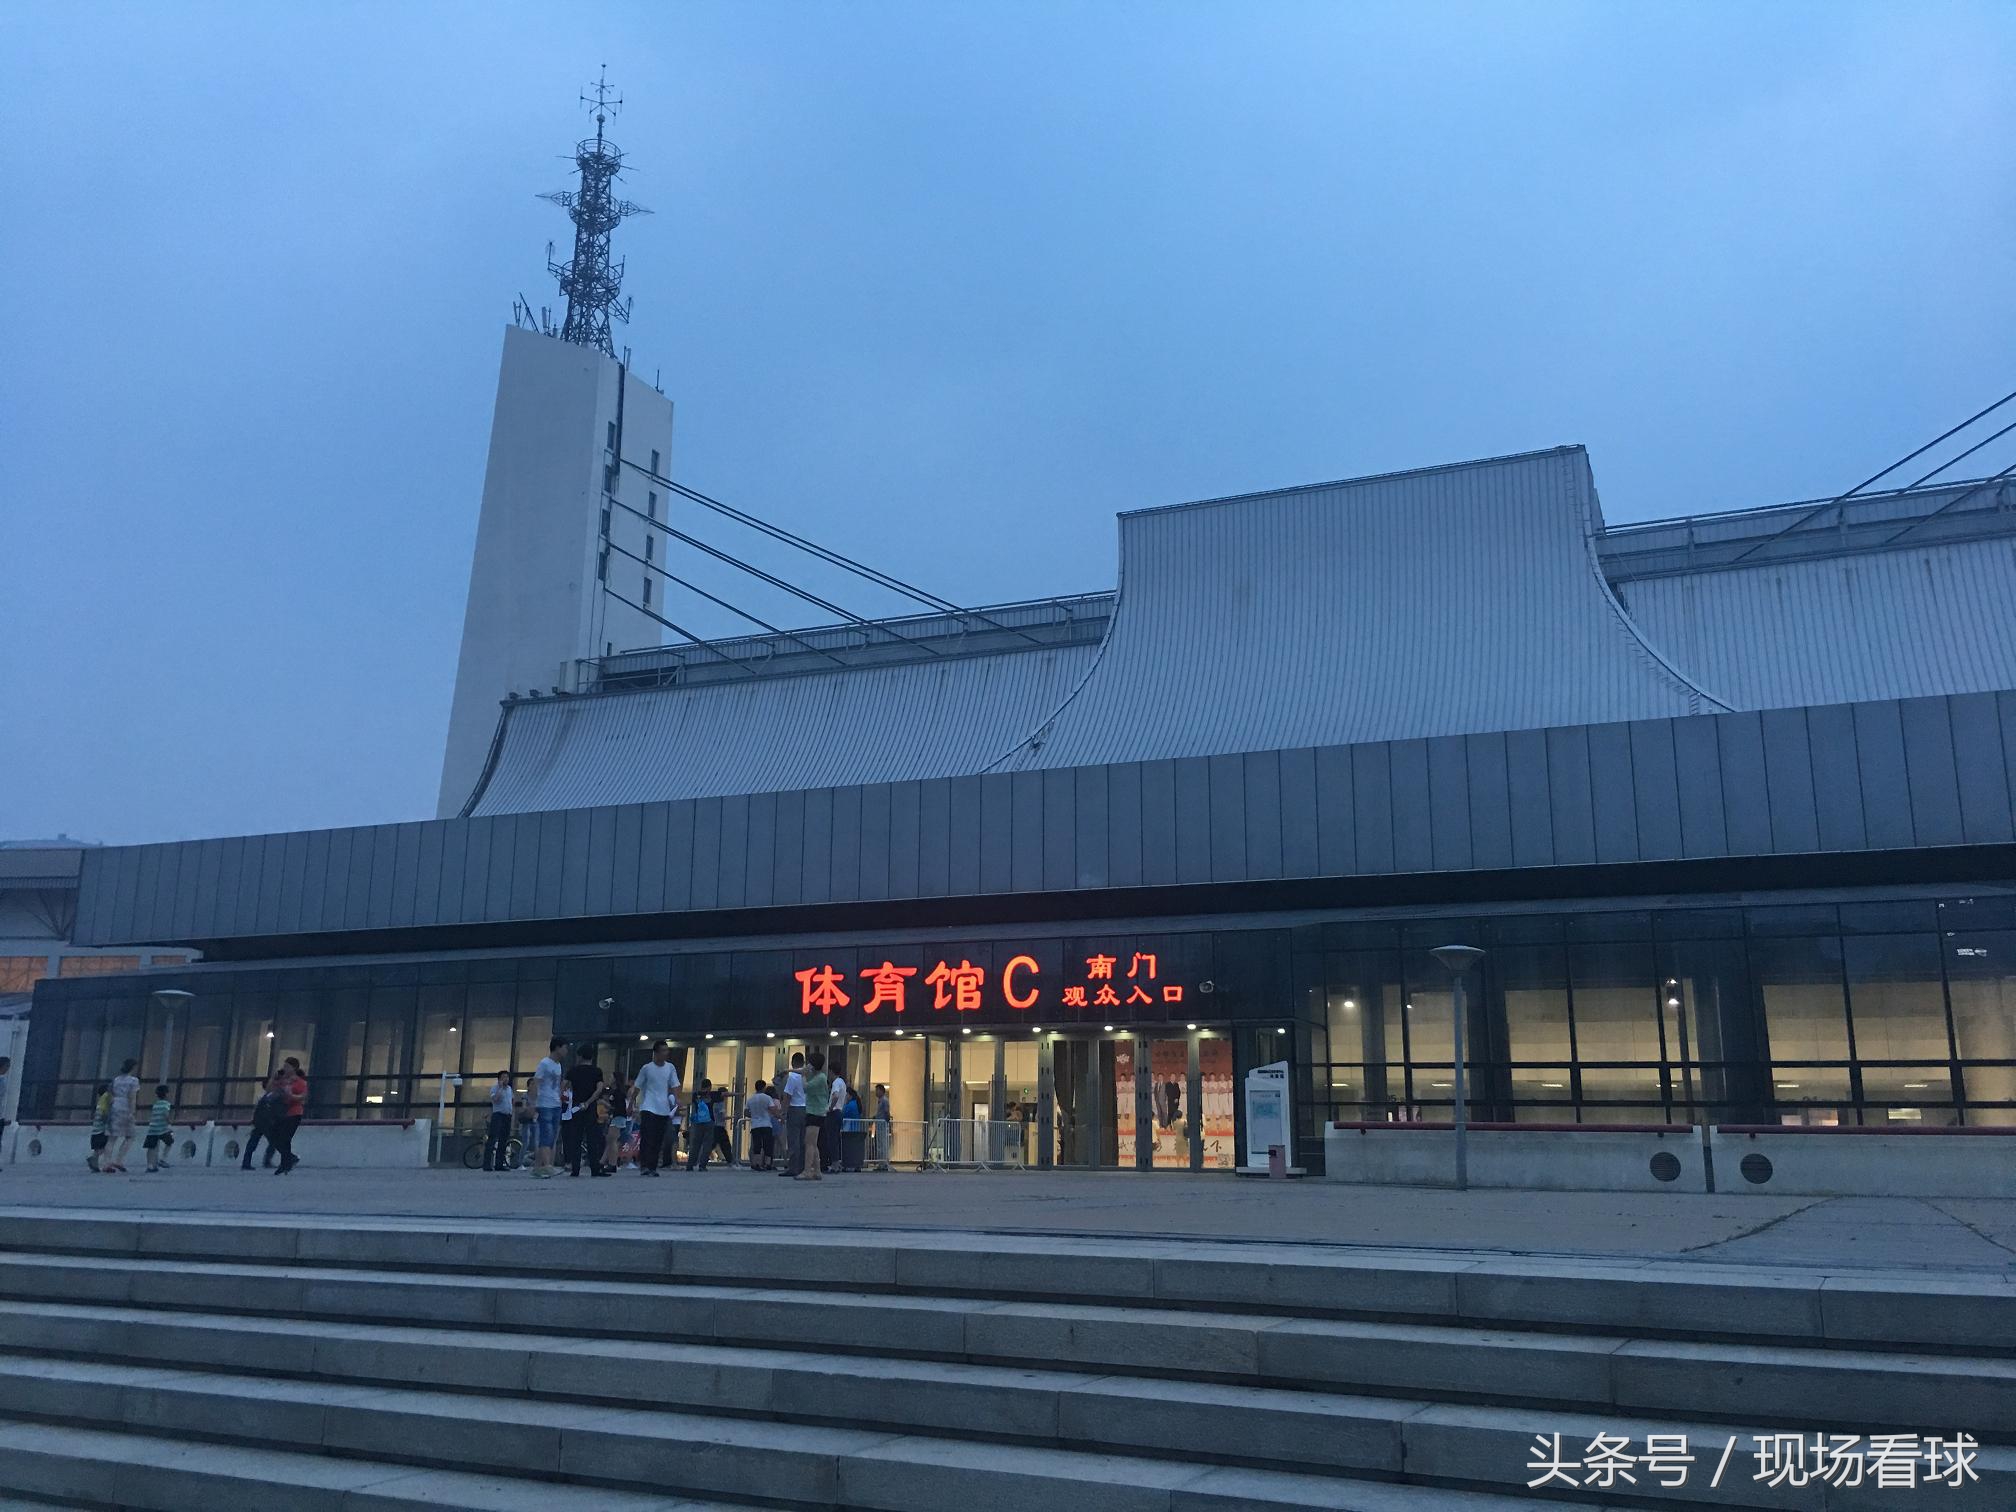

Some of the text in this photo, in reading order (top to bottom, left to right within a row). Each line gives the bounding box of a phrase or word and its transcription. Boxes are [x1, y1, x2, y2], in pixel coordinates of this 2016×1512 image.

[1086, 952, 1157, 979] 南门
[1062, 984, 1183, 1007] 观众入口
